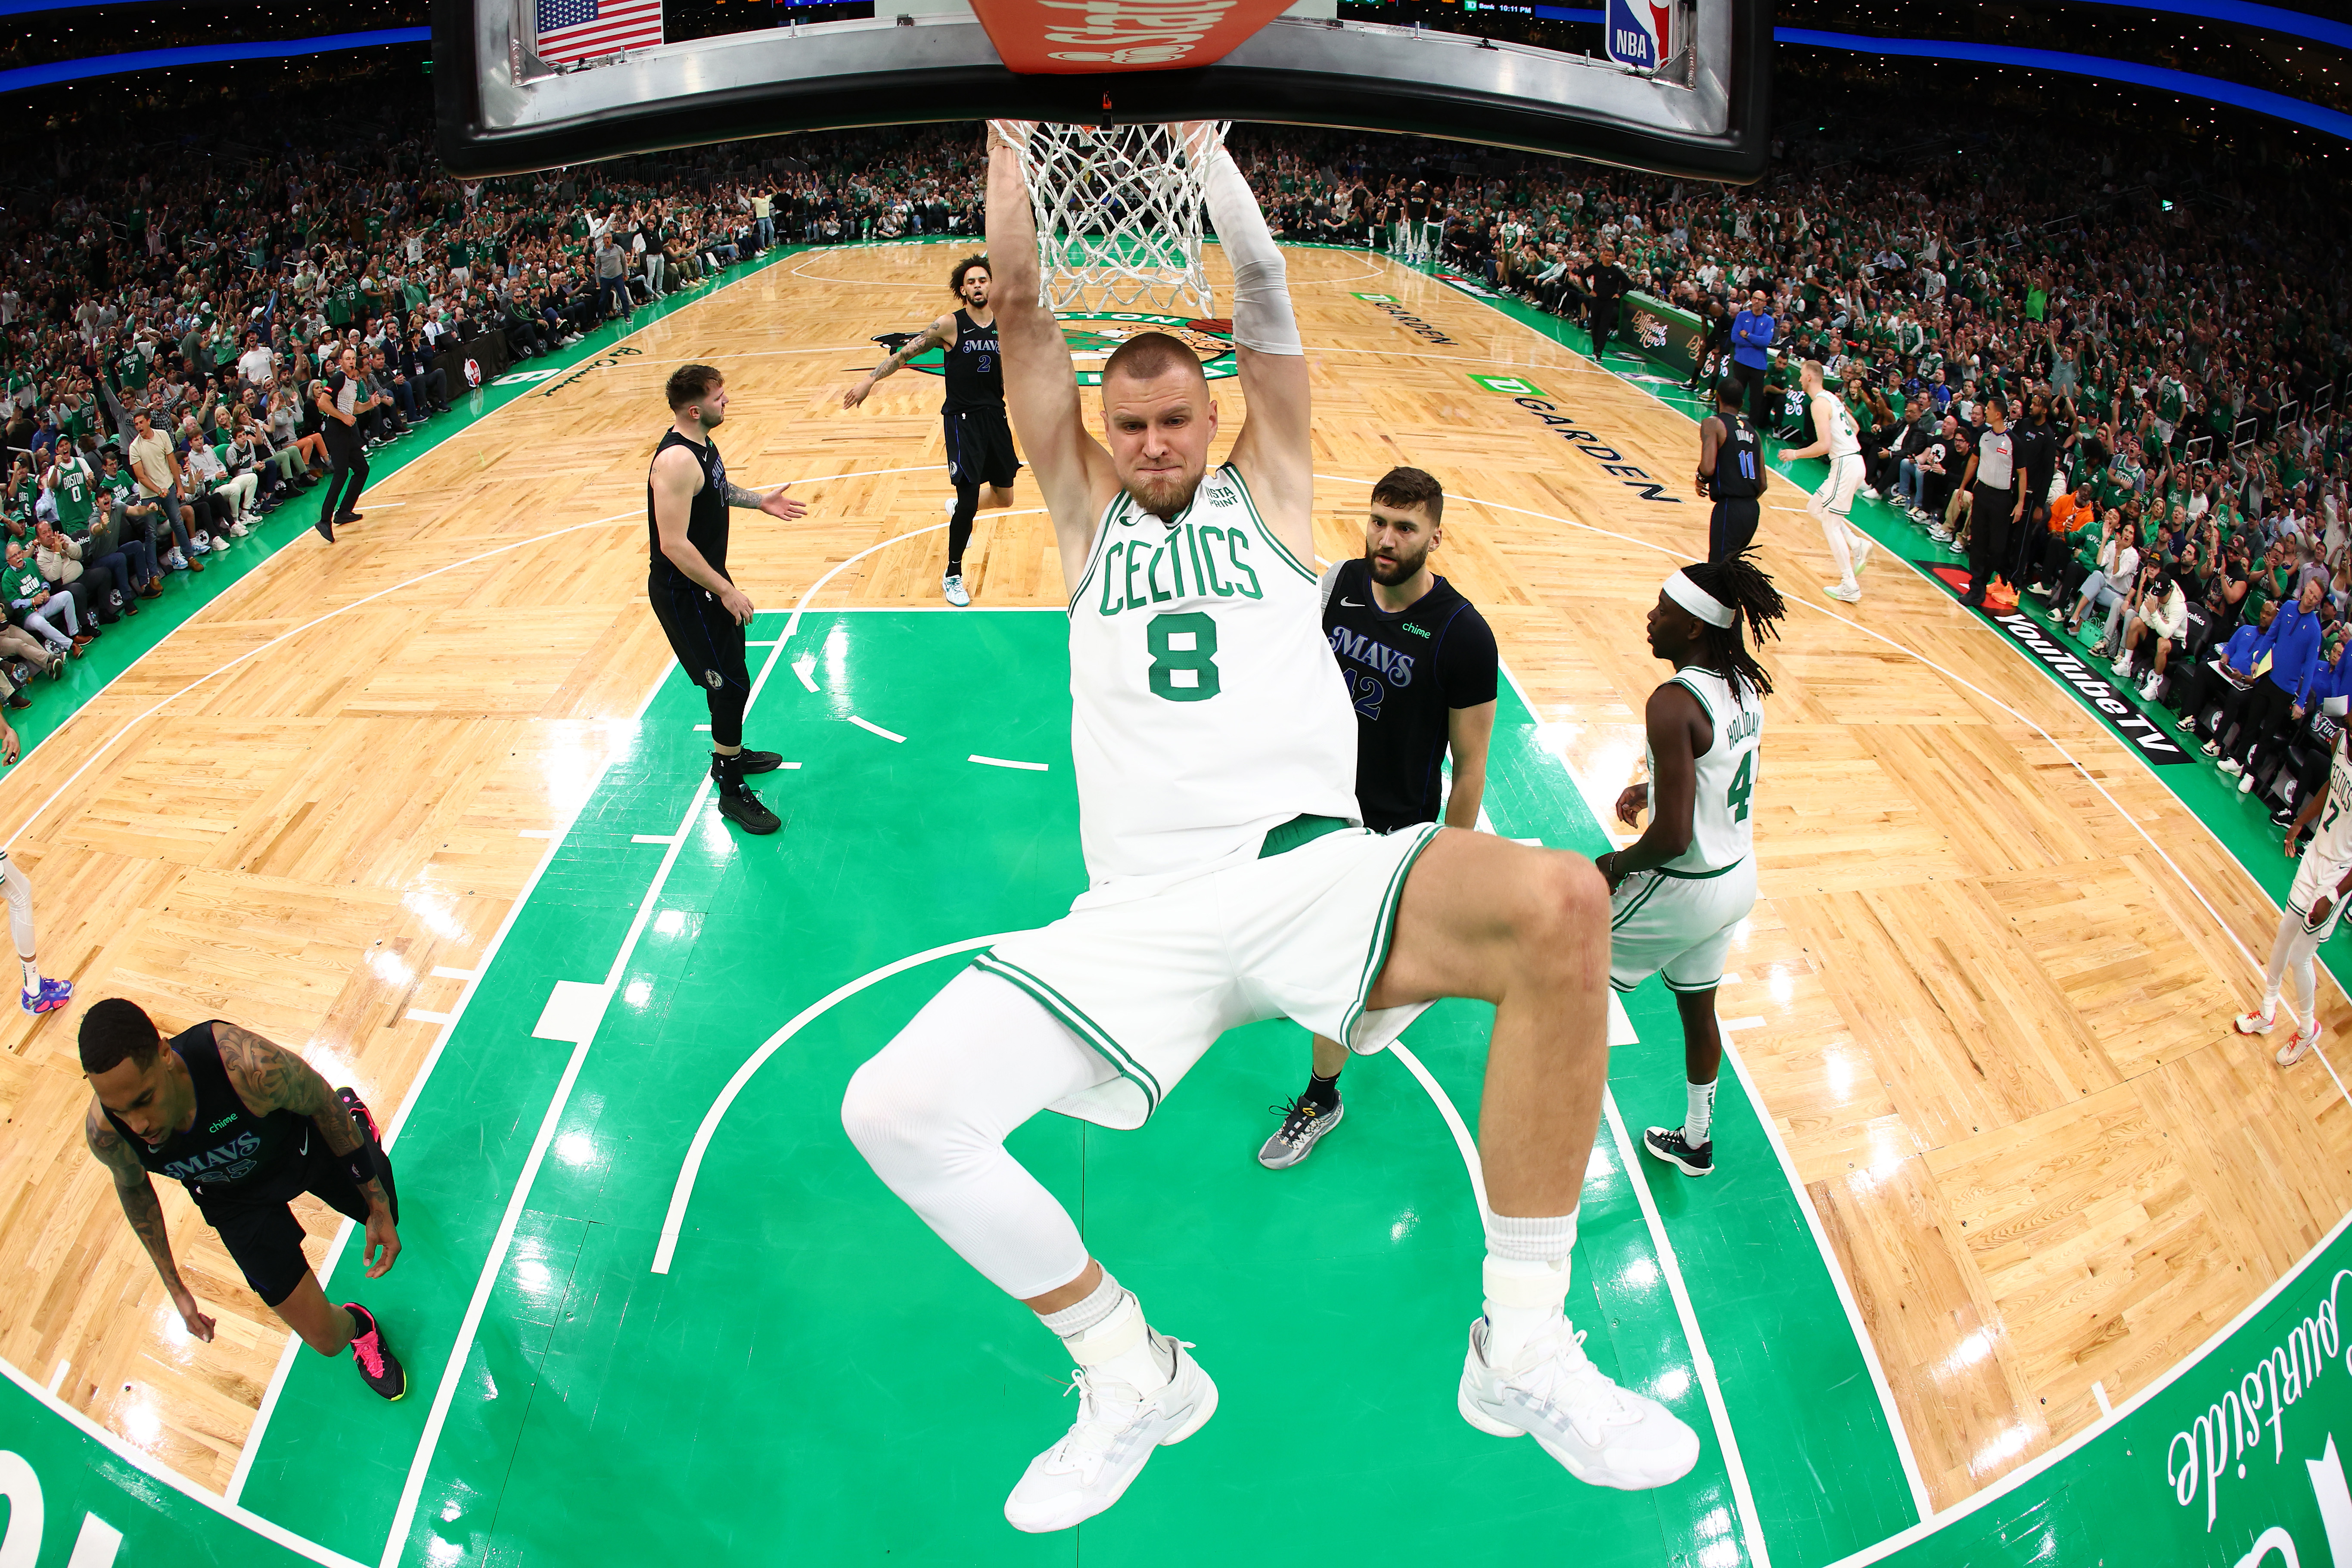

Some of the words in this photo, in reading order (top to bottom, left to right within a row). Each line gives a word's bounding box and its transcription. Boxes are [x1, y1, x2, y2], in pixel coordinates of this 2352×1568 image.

[1466, 1, 1476, 9] TD
[1037, 0, 1237, 44] Stat
[1616, 29, 1647, 59] NBA
[1052, 312, 1183, 325] STON
[1373, 302, 1459, 346] GARDEN
[1631, 310, 1668, 337] Different
[124, 354, 139, 365] BOSTON
[128, 363, 135, 374] 7
[977, 355, 991, 373] 2
[1483, 378, 1534, 394] TD
[2164, 394, 2171, 404] 7
[82, 405, 94, 417] BOST
[87, 416, 92, 428] 0
[1513, 397, 1684, 503] GARDEN
[712, 453, 725, 489] MAV
[1738, 450, 1755, 480] 11
[63, 472, 84, 490] BOSTON
[71, 486, 82, 503] 0
[114, 486, 130, 500] OSTON
[719, 475, 728, 508] 77
[1206, 486, 1233, 499] VISTA
[1209, 495, 1239, 508] PRINT
[76, 536, 90, 545] eltics
[1099, 524, 1264, 616] CELTICS
[19, 576, 40, 596] BOSTON
[2187, 612, 2206, 627] celtics
[1402, 621, 1431, 639] chime
[1146, 612, 1222, 702] 8
[1328, 625, 1416, 688] MAVS
[1994, 613, 2128, 718] YouTube
[2116, 713, 2180, 753] TV
[1727, 711, 1761, 750] HOLIDAY
[2312, 716, 2340, 739] Fin
[1727, 749, 1752, 824] 4
[2323, 798, 2340, 833] 7
[209, 1112, 238, 1133] chime
[164, 1131, 261, 1180] MAVS
